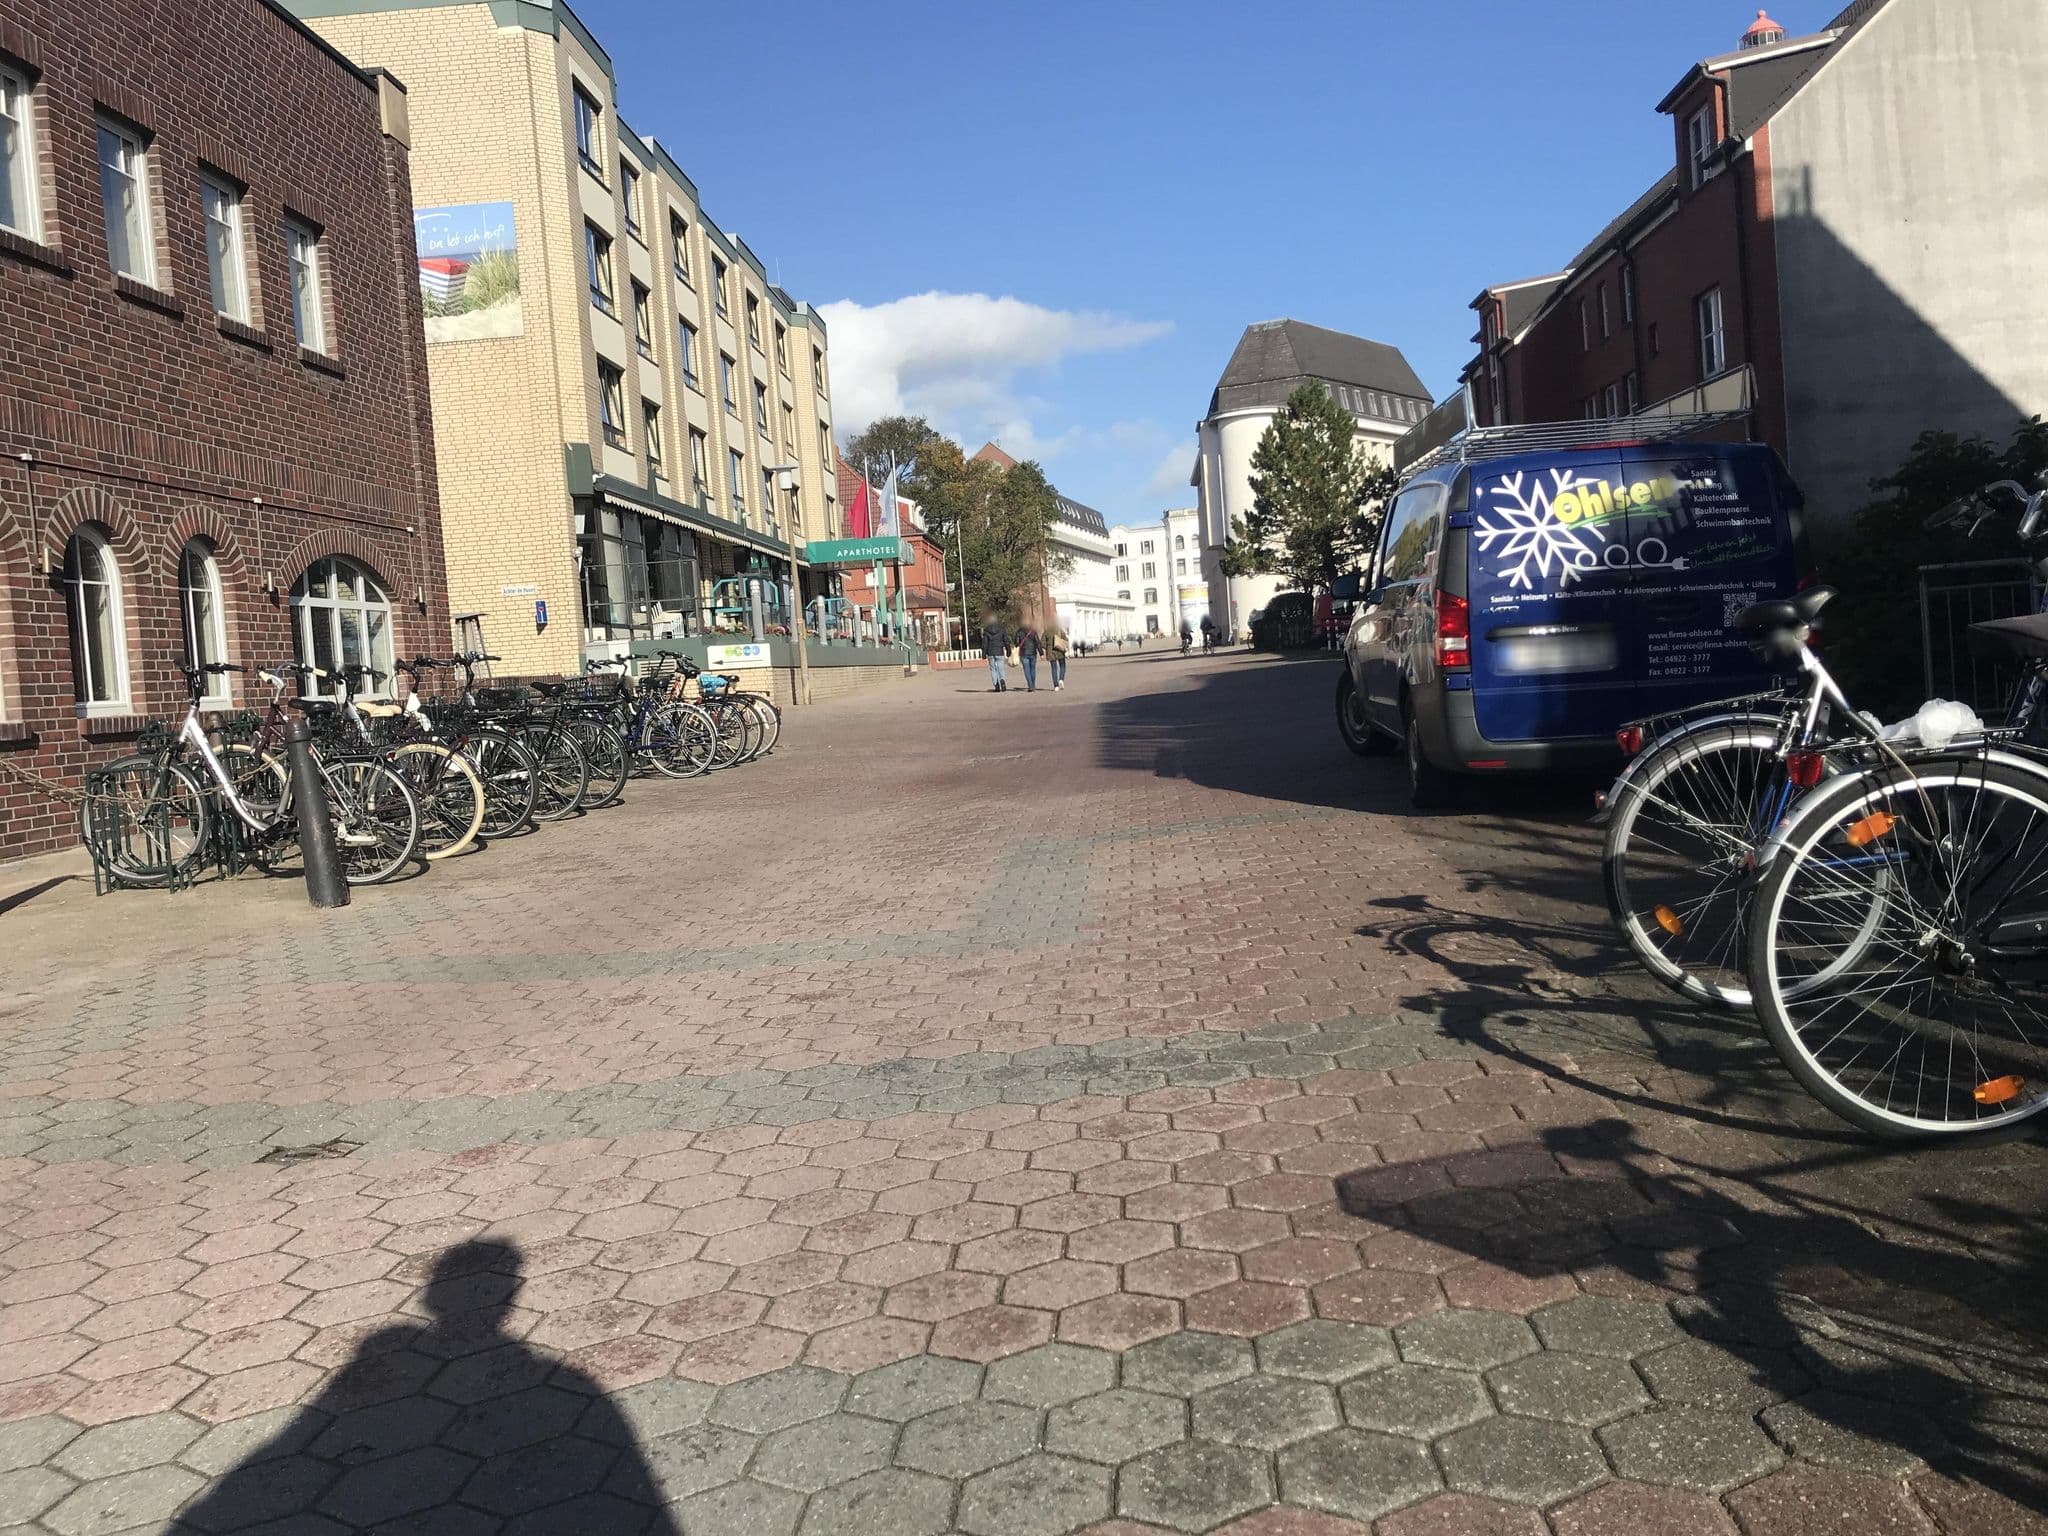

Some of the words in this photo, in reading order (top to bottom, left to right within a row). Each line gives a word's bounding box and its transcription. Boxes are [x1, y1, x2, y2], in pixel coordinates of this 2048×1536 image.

[1690, 469, 1717, 478] Sanitär
[1693, 492, 1740, 502] Kältetechnik
[1694, 504, 1750, 516] Bauklempnerei
[1695, 516, 1772, 528] Schwimmbadtechnik
[836, 545, 896, 558] APARTHOTEL
[1490, 594, 1515, 604] Sanitär
[1520, 592, 1549, 602] Heizung
[1678, 582, 1745, 592] Schwimmbadtechnik
[1751, 580, 1777, 589] Lüftung
[1648, 628, 1724, 640] www.firma-ohlsen.de
[1664, 654, 1687, 663] 04922
[1693, 653, 1711, 662] 3777
[1664, 666, 1687, 675] 04922
